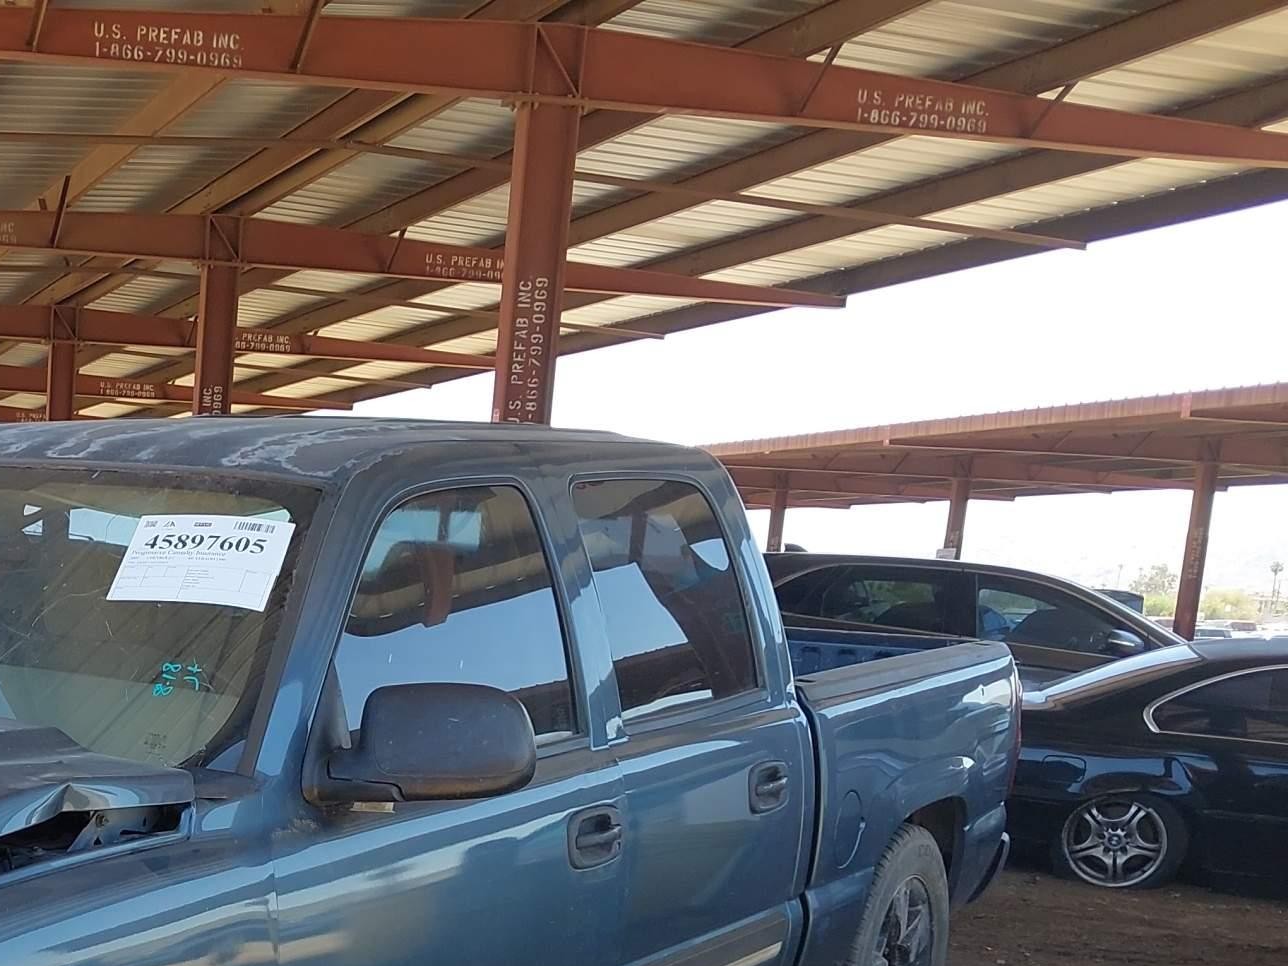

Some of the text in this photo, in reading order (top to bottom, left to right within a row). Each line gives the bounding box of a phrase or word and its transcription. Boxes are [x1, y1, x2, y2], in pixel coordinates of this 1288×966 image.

[94, 21, 245, 50] U.S. PREFAB INC.
[95, 41, 243, 68] 1-866-799-0969
[857, 88, 990, 117] U.S. PREFAB INC.
[857, 107, 987, 134] 1-866-799-0969
[451, 255, 492, 269] PREFAB
[516, 275, 533, 308] INC.
[242, 332, 273, 343] PREFAB
[510, 316, 529, 385] PREFAB
[144, 533, 268, 555] 45897605
